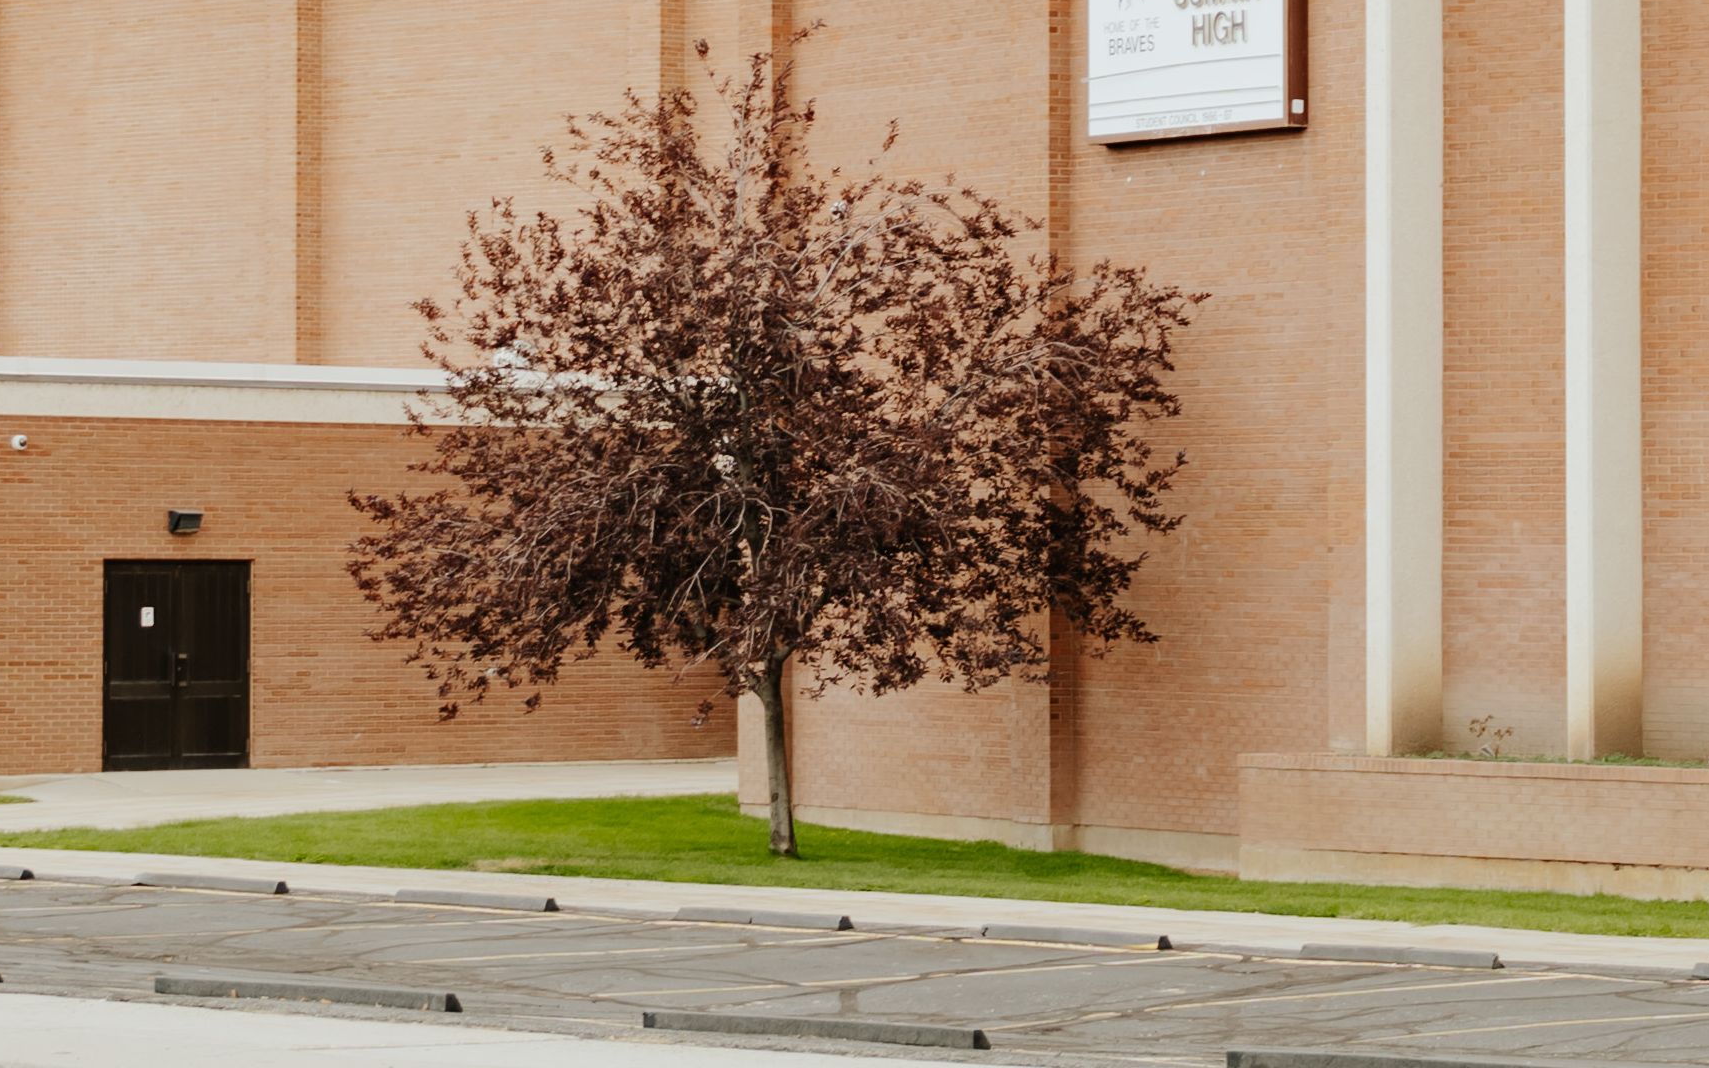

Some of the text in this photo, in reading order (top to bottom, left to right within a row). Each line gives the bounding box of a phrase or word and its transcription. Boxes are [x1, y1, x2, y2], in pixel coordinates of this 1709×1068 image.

[1104, 16, 1160, 34] HOME OF THE
[1192, 10, 1248, 47] HIGH
[1109, 34, 1155, 56] BRAVES
[1169, 113, 1199, 126] COUNCIL
